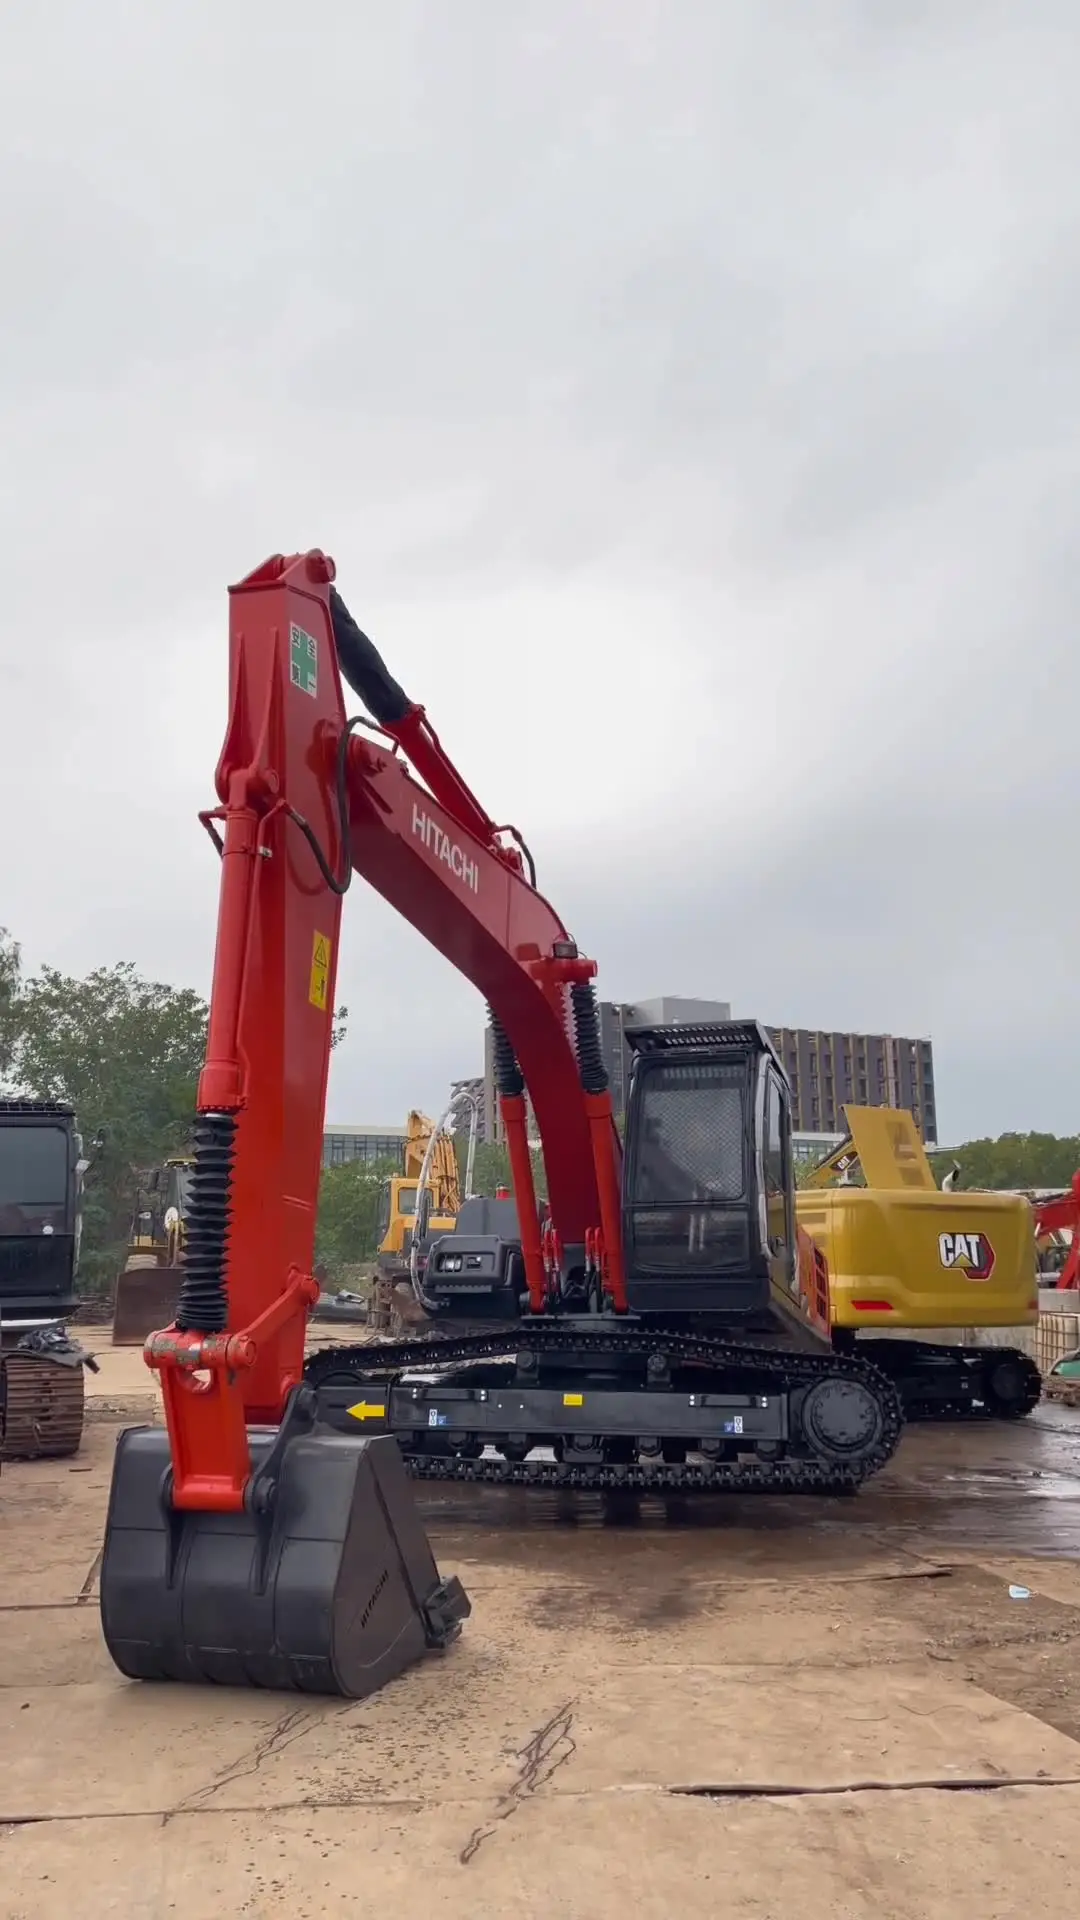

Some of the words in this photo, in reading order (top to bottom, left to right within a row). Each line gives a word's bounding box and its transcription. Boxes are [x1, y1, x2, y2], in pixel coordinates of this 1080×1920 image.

[412, 803, 479, 895] HITACHI
[837, 1155, 850, 1170] CAT
[938, 1233, 980, 1268] CAT
[361, 1569, 389, 1628] HITACHI
